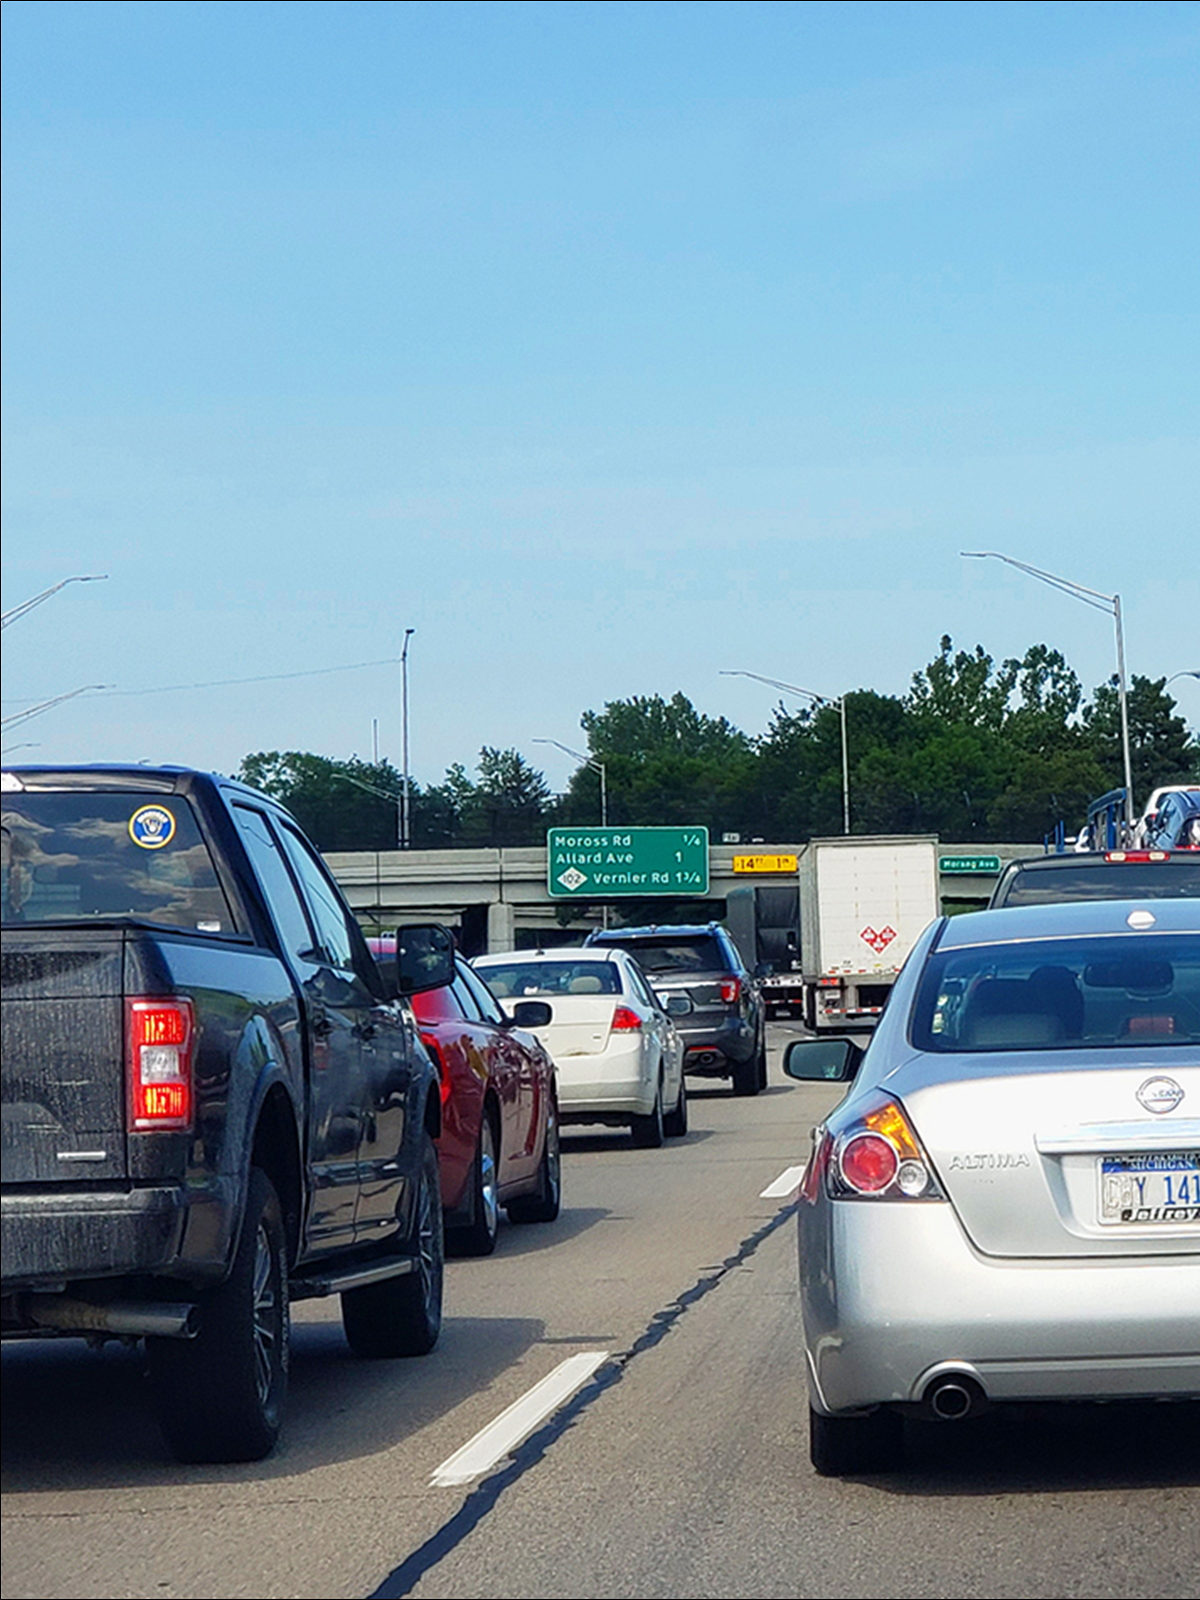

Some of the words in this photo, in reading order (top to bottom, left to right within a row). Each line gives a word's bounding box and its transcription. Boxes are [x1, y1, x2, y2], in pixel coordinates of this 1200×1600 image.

[554, 835, 609, 848] Moross
[612, 834, 632, 847] Rd
[555, 852, 602, 865] Allard
[605, 852, 634, 865] Ave
[674, 851, 682, 863] 1
[978, 860, 995, 868] Ave
[563, 873, 582, 884] 102
[593, 872, 648, 885] Vernier
[651, 872, 670, 884] Rd
[949, 1153, 1031, 1170] ALTIMA
[1130, 1160, 1194, 1171] MICHIGAN
[1128, 1207, 1199, 1222] Jeffrey
